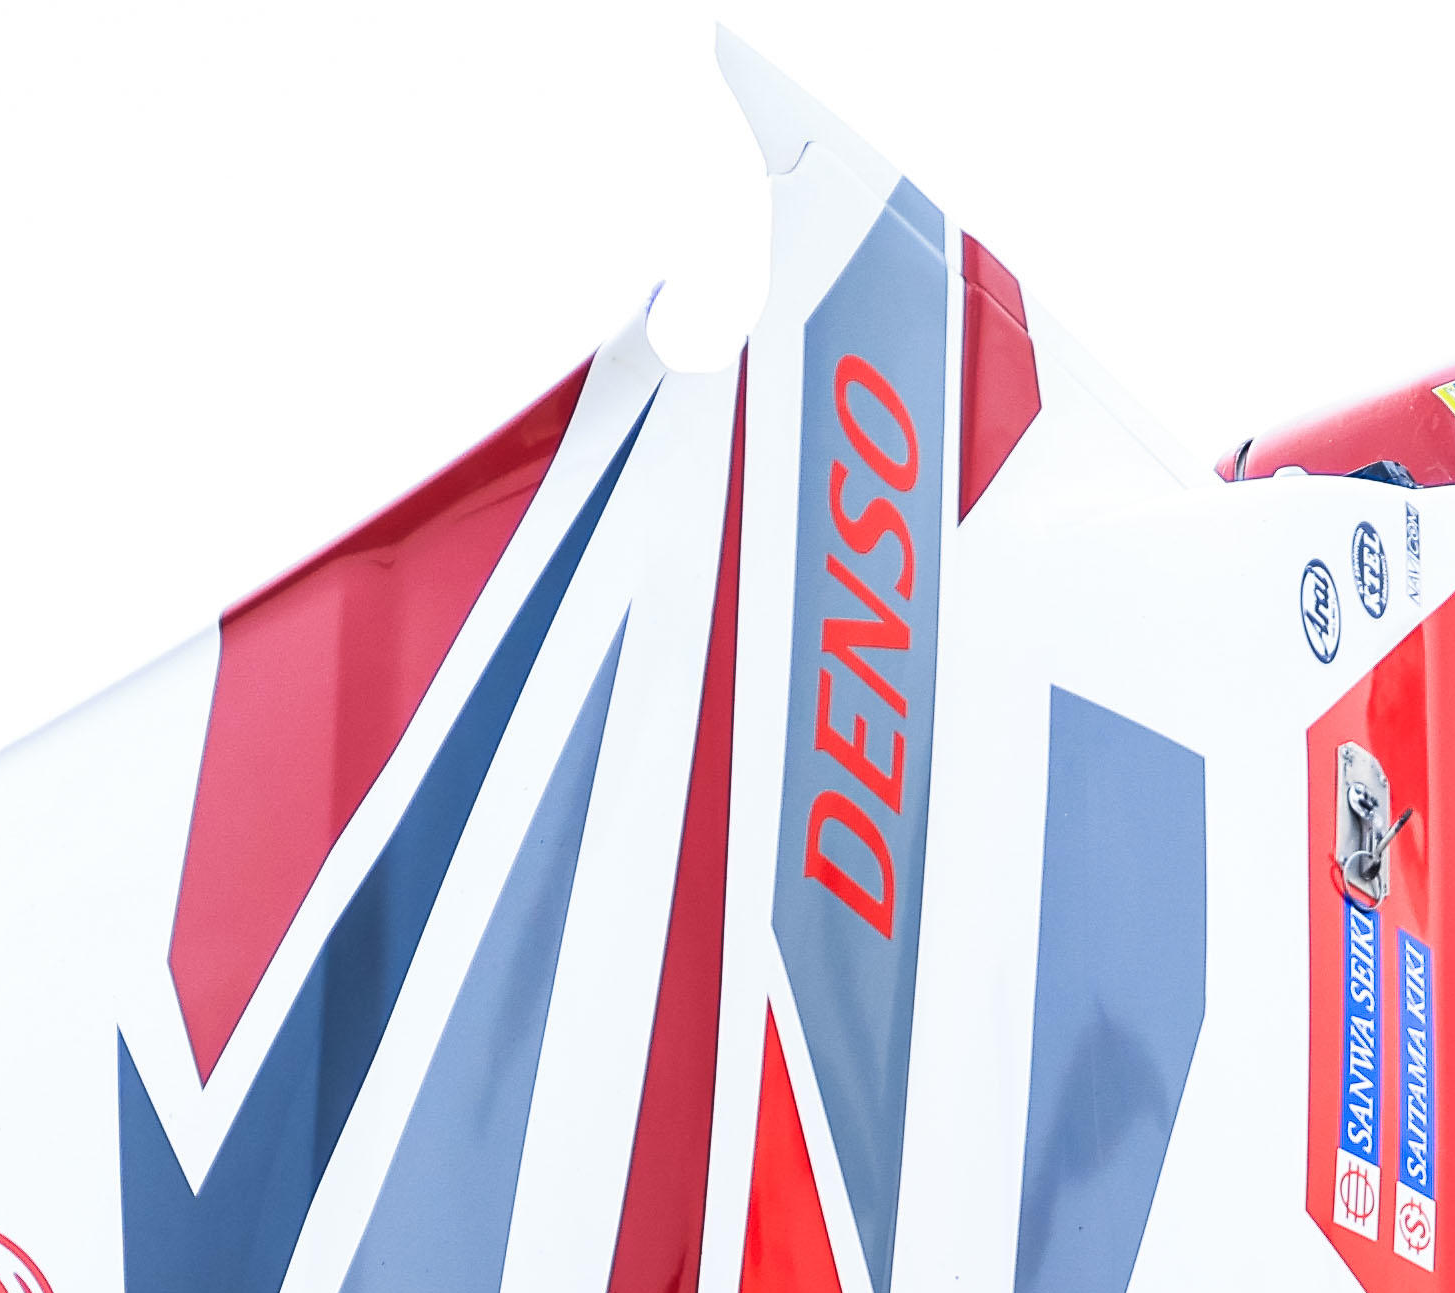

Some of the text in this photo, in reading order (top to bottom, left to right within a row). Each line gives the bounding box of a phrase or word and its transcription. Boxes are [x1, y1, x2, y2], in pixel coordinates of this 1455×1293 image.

[804, 353, 920, 940] DENSO
[1305, 564, 1330, 657] Arai
[1347, 905, 1376, 1153] SANWA SEIKI
[1404, 940, 1427, 1185] SAITAMA KIKI
